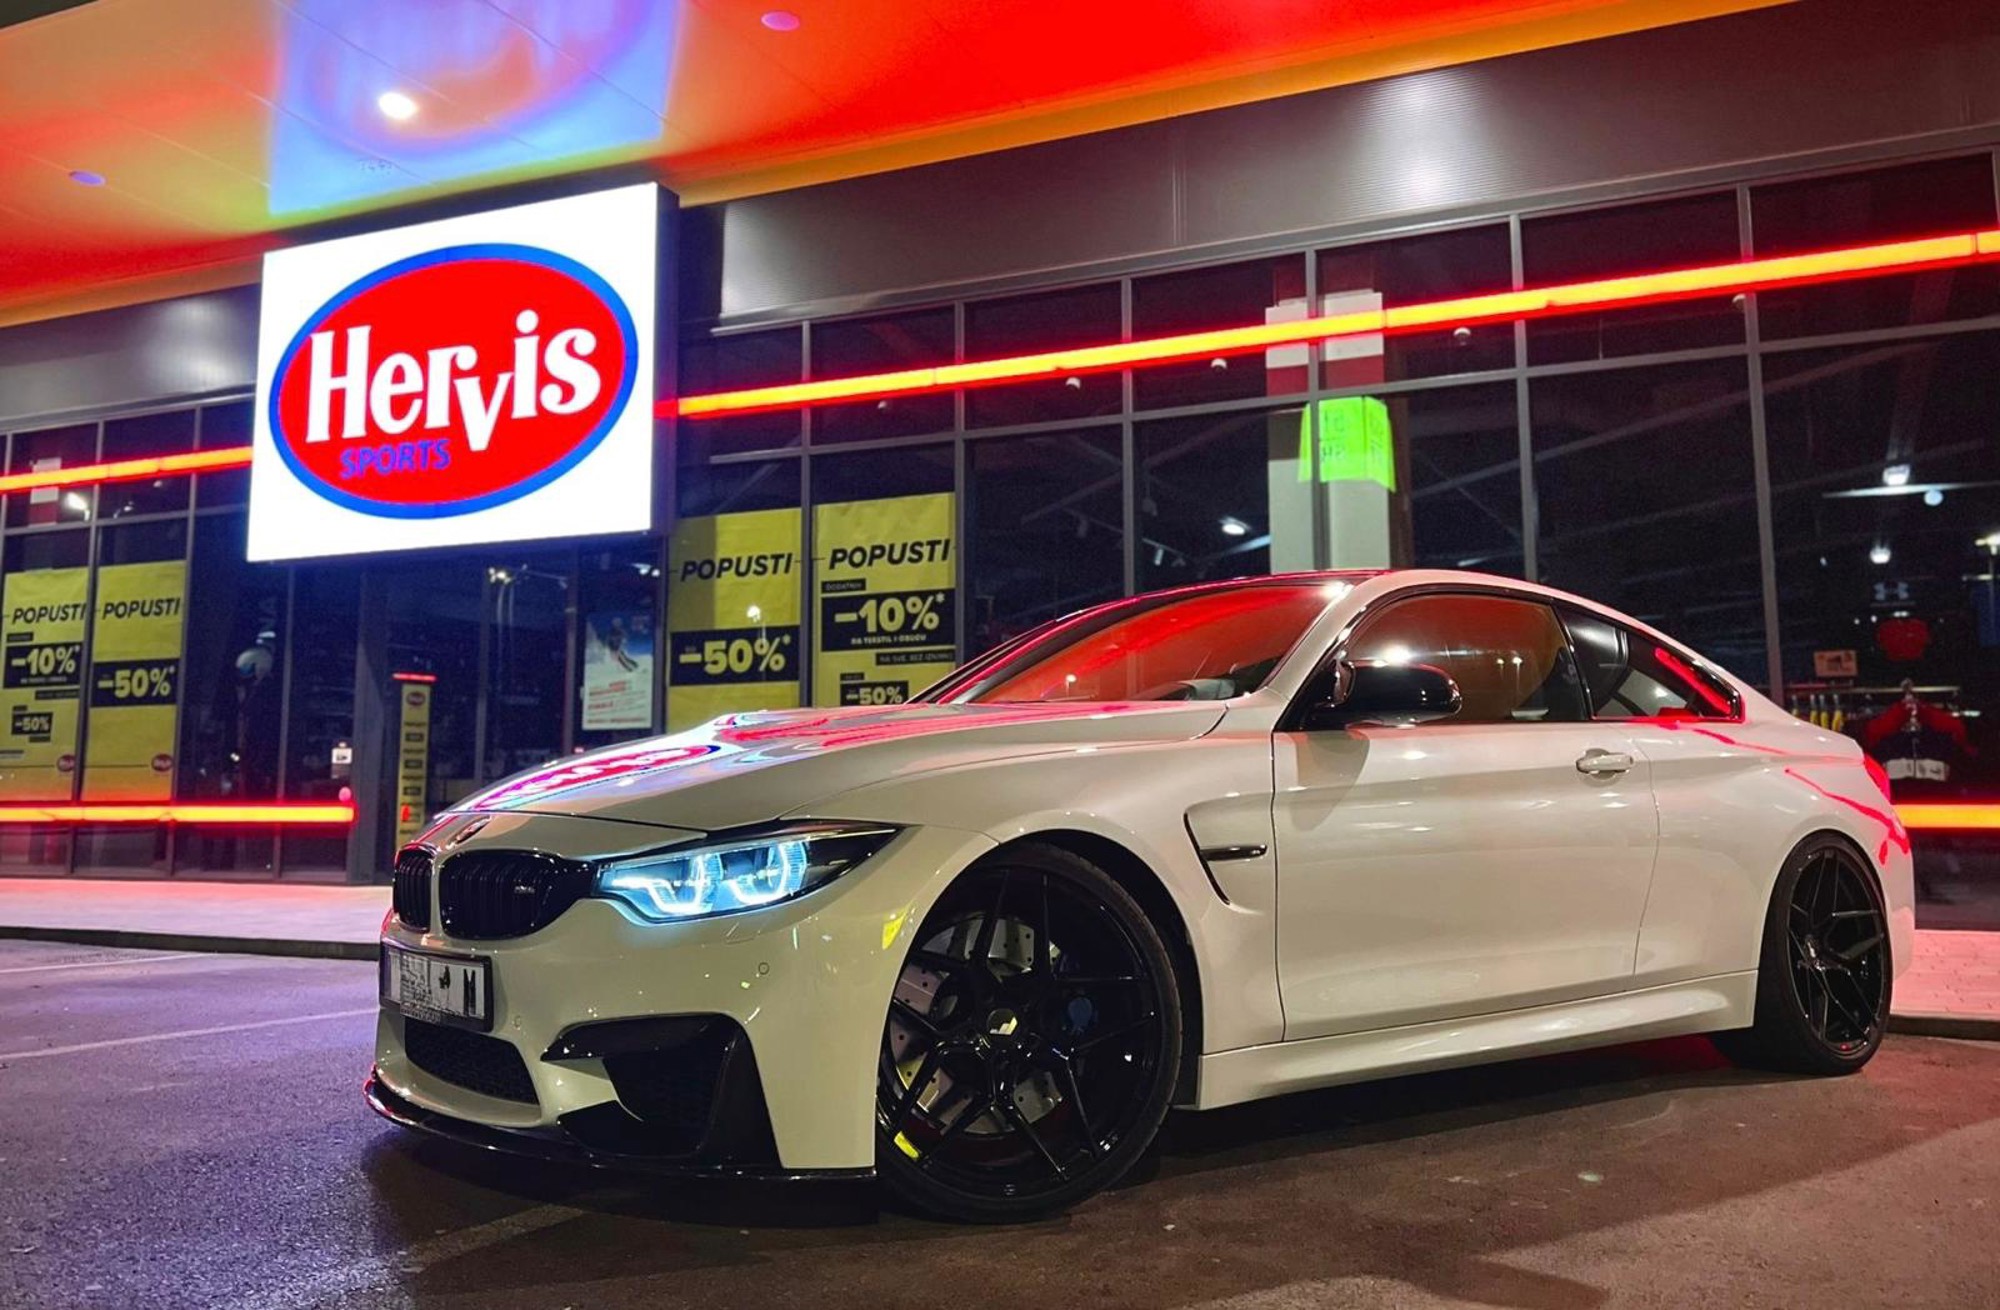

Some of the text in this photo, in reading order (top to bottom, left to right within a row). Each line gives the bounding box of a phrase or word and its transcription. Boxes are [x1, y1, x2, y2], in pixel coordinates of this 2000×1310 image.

[306, 309, 601, 452] Hervis
[341, 439, 451, 479] SPORTS
[681, 553, 793, 581] POPUSTI
[829, 539, 951, 570] POPUSTI
[12, 603, 87, 625] POPUSTI
[102, 598, 180, 620] POPUSTI
